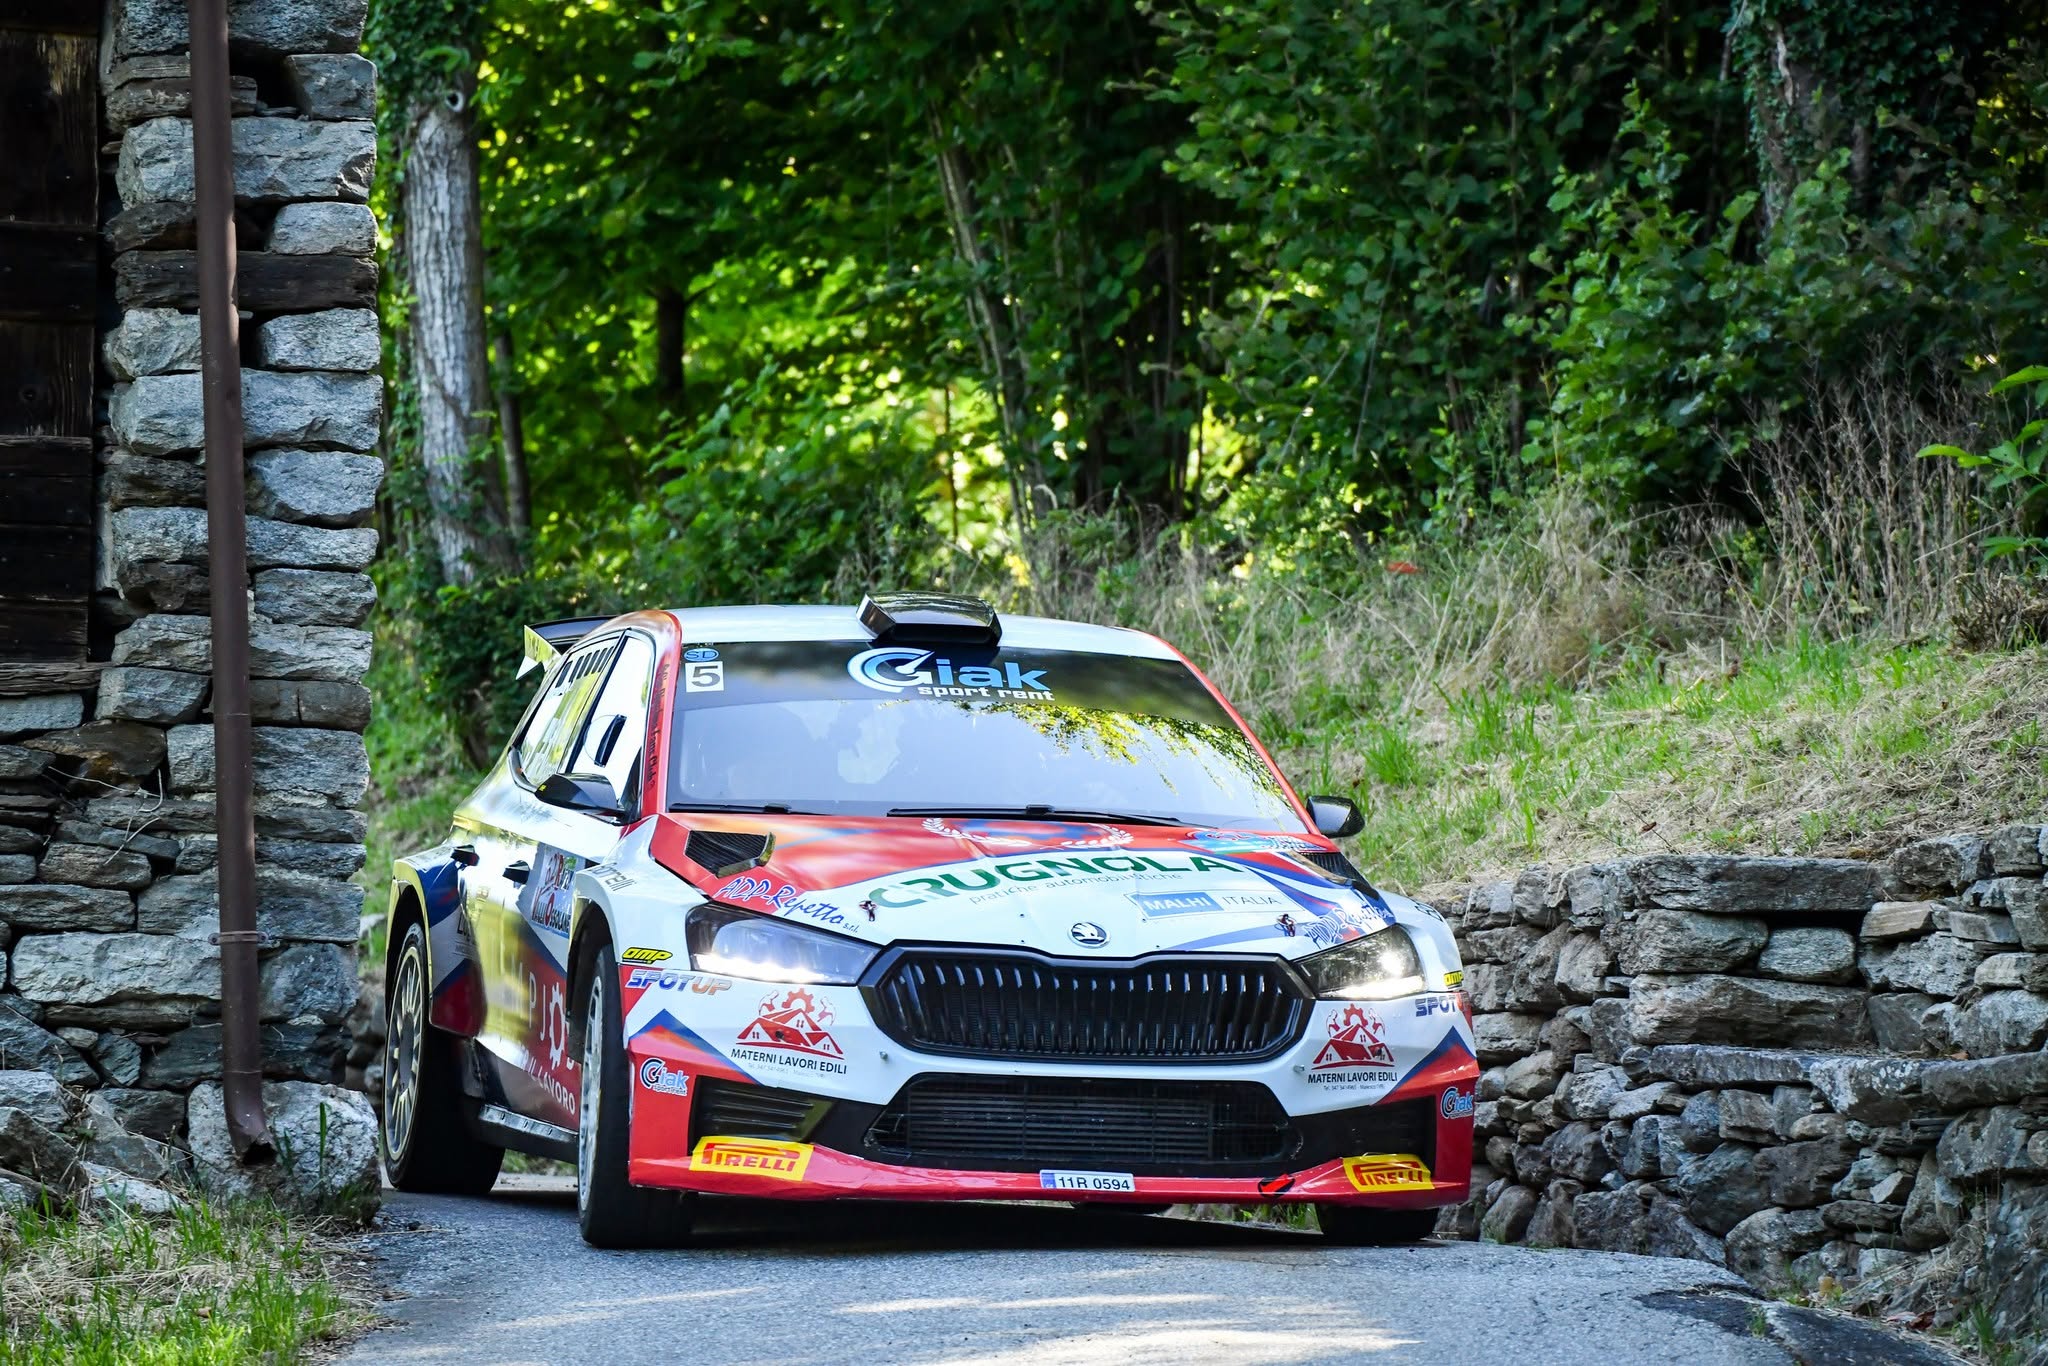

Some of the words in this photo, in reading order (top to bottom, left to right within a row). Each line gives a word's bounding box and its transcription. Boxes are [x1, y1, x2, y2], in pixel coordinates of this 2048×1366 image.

[691, 665, 721, 688] 5
[918, 686, 990, 698] sport
[997, 689, 1056, 702] rent
[867, 855, 1244, 909] CRUGNOLA
[969, 883, 1038, 904] pratiche
[1144, 896, 1211, 911] MALHI
[1223, 895, 1282, 906] ITALIA
[625, 969, 732, 995] SPOTUP
[731, 1048, 777, 1063] MATERNI
[779, 1055, 818, 1070] LAVORI
[820, 1061, 848, 1075] EDILI
[1308, 1073, 1346, 1084] MATERNI
[1347, 1071, 1377, 1082] LAVORI
[1378, 1071, 1398, 1082] EDILI
[702, 1143, 800, 1172] PIRELLI
[1059, 1176, 1088, 1189] 11R
[1093, 1177, 1130, 1190] 0594
[1352, 1161, 1423, 1186] PIRELLI
